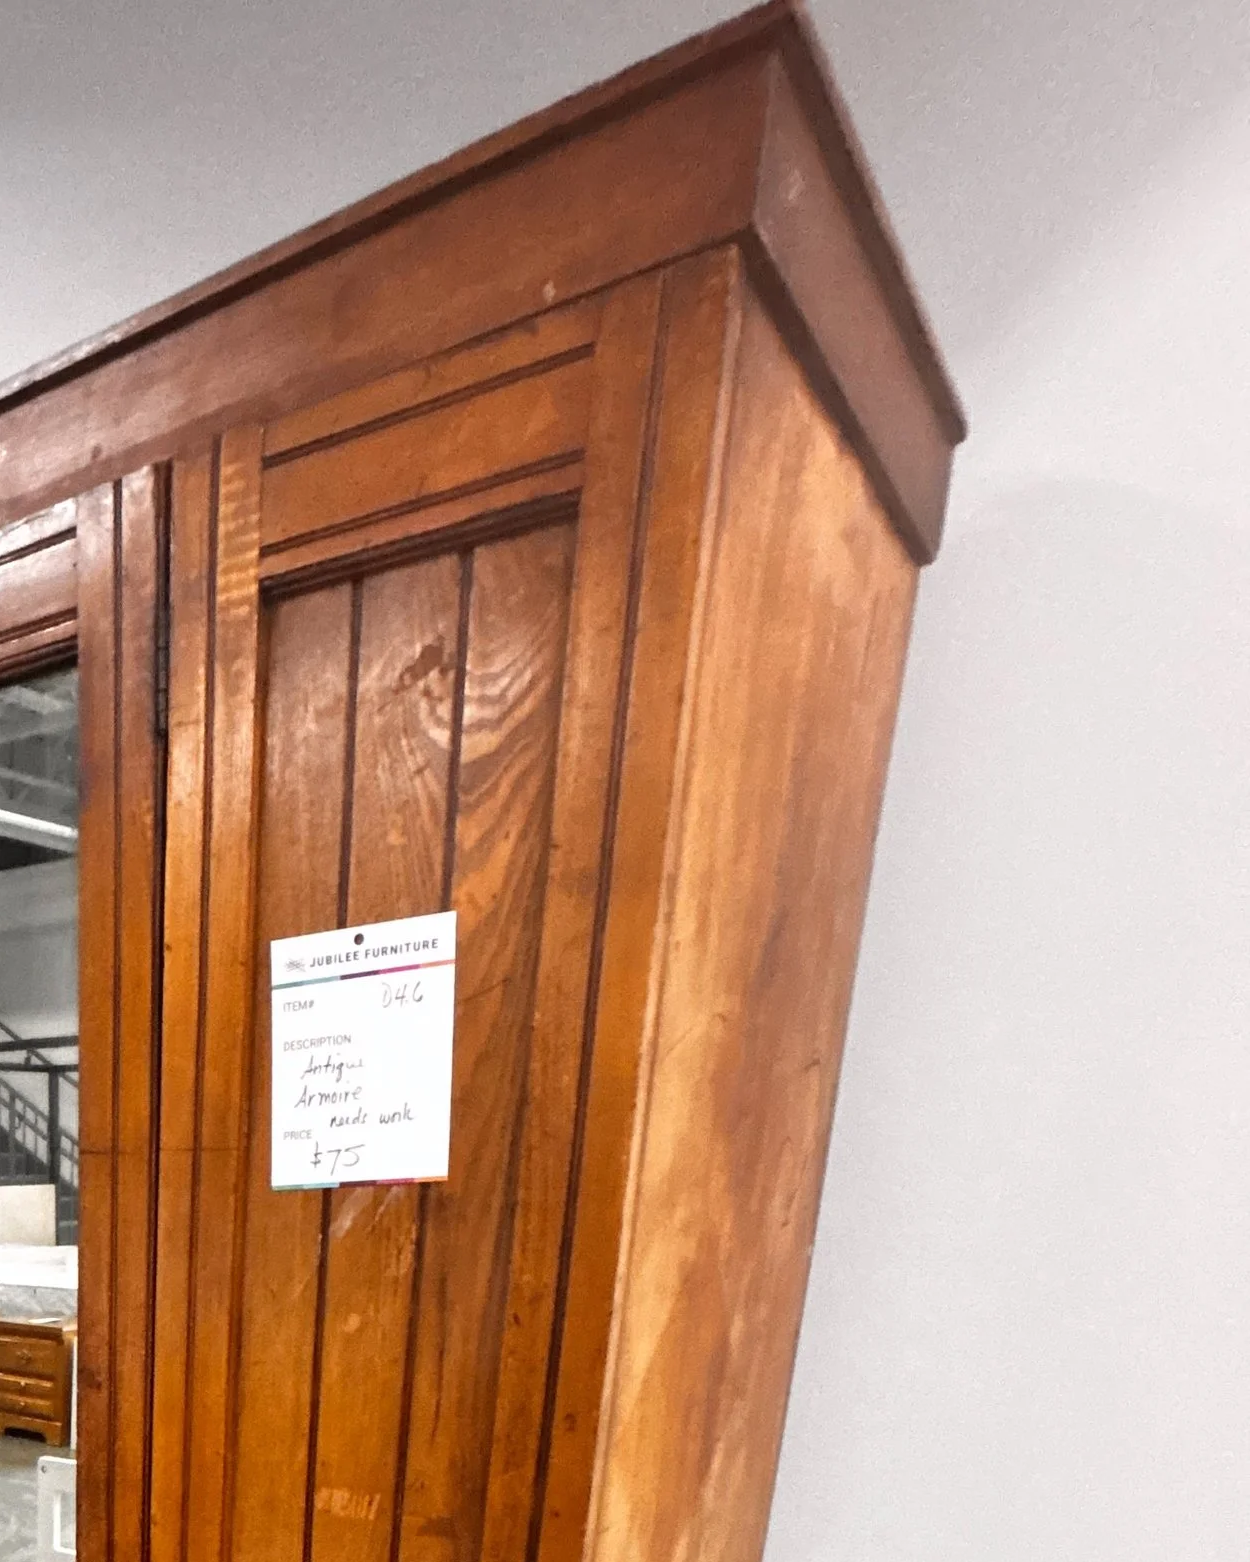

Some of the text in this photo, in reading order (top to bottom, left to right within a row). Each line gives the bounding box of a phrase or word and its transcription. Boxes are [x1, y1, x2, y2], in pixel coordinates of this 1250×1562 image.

[309, 938, 439, 968] JUBILEE FURNITURE
[283, 1000, 315, 1012] ITEM#
[283, 1034, 352, 1052] DESCRIPTION
[294, 1081, 362, 1108] Armoire
[330, 1102, 417, 1128] needs work
[283, 1129, 312, 1141] PRICE
[310, 1141, 365, 1176] $75
